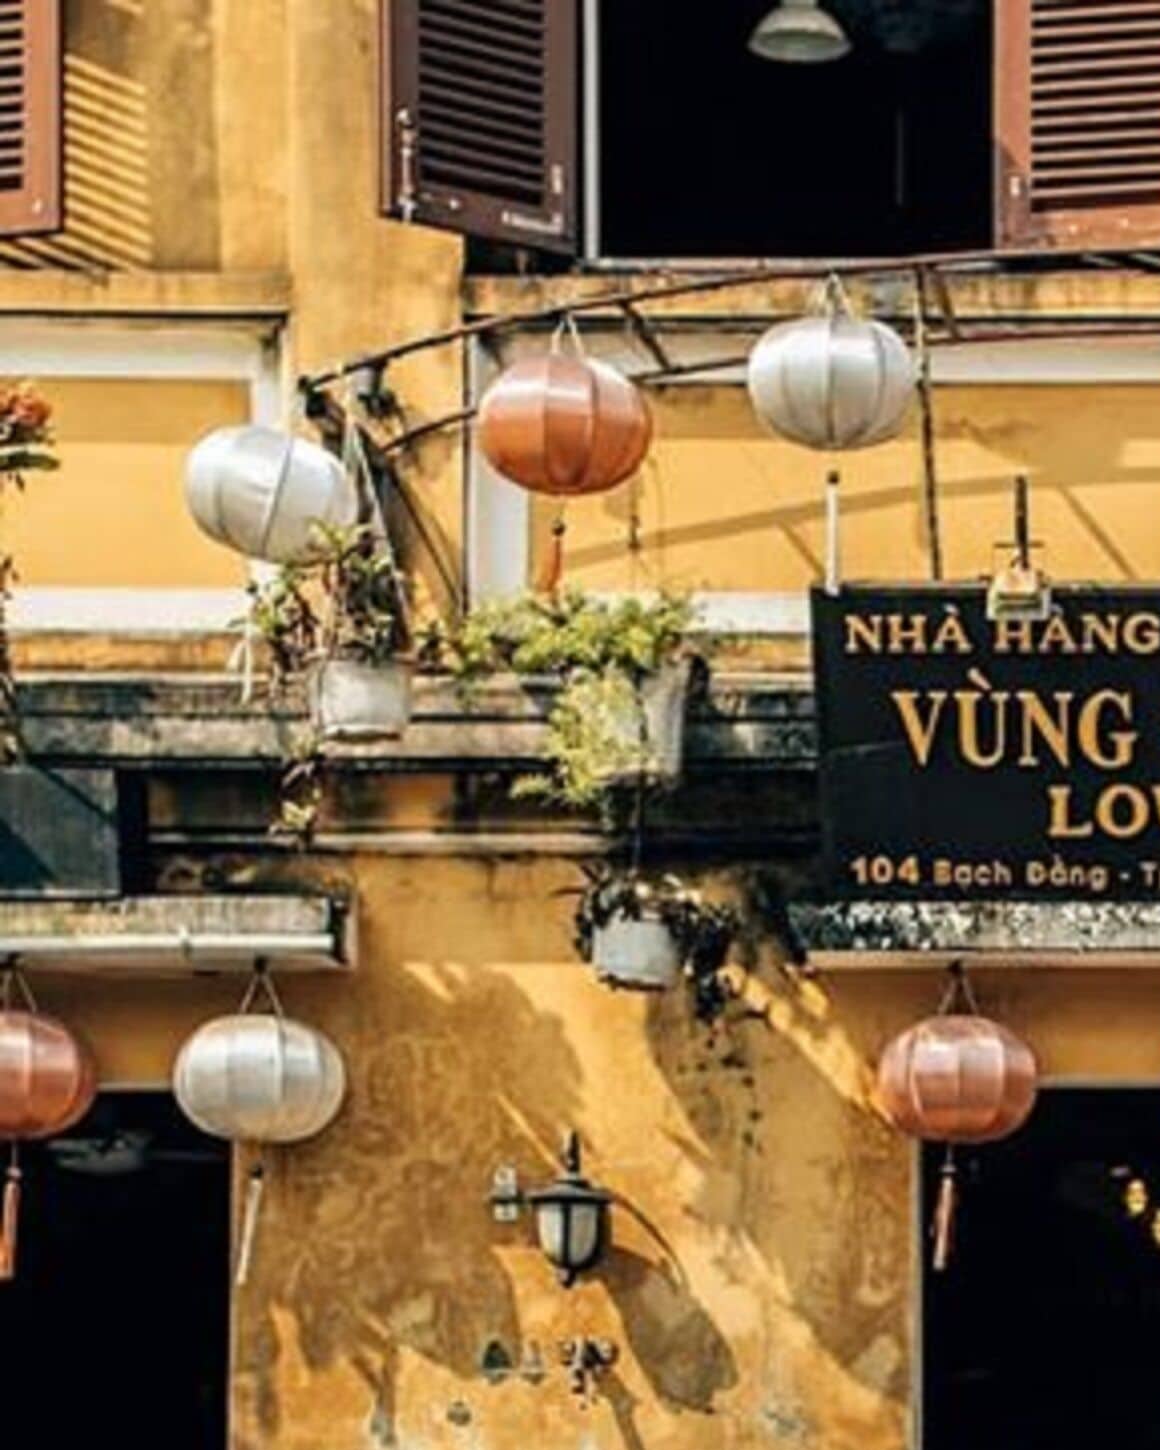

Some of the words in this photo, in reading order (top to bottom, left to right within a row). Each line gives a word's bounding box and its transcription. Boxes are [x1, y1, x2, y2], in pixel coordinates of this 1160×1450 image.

[845, 604, 972, 653] NHÀ
[994, 604, 1160, 654] HÀNG
[891, 667, 1138, 768] VÙNG
[851, 855, 919, 884] 104
[933, 859, 1012, 892] Bạch
